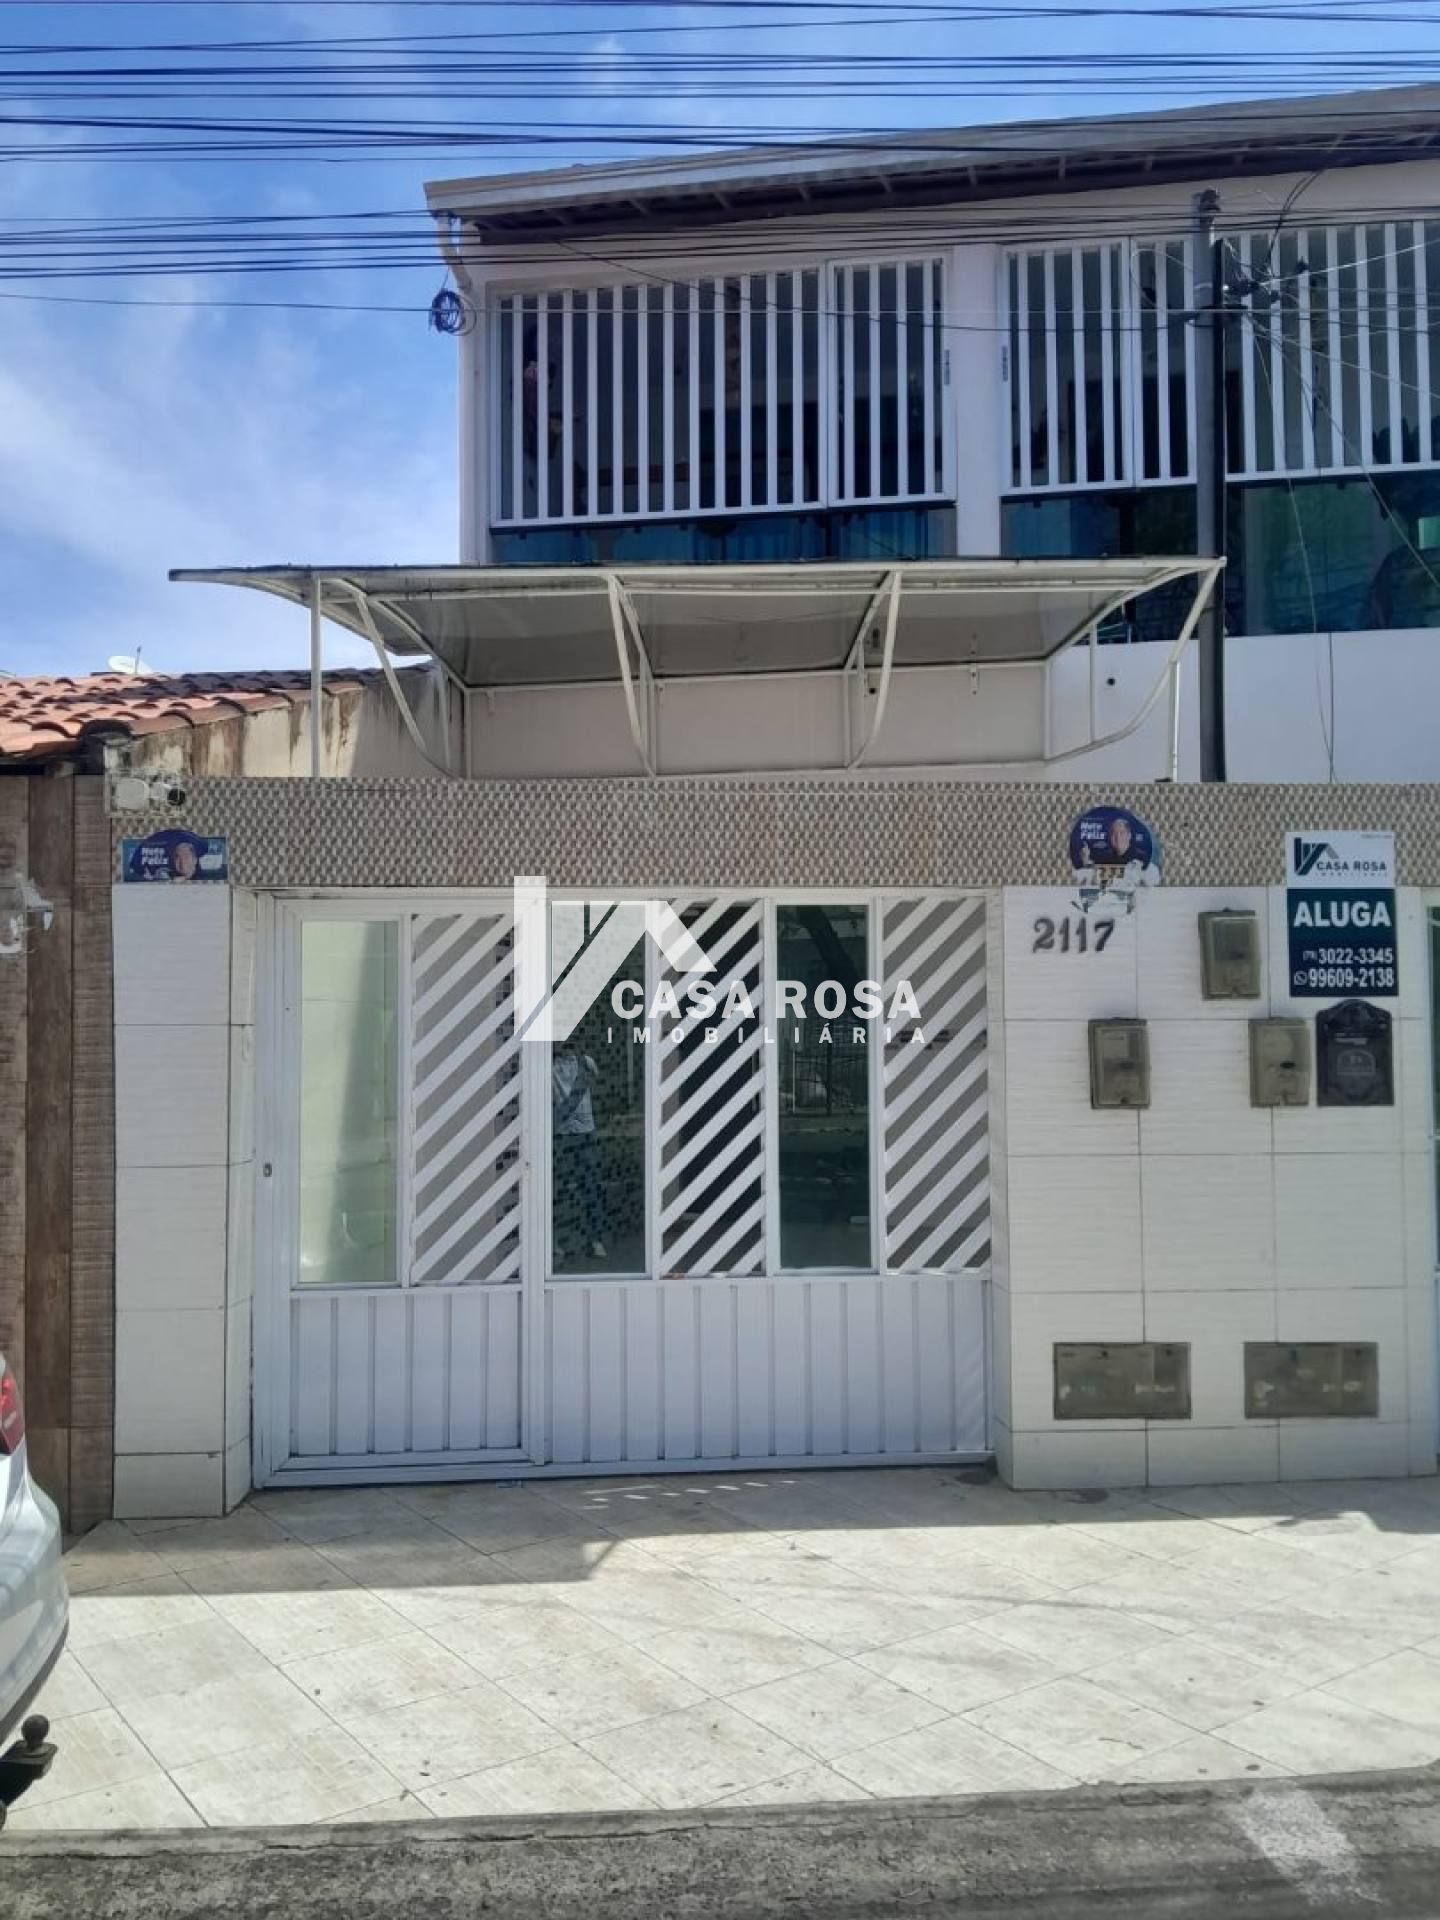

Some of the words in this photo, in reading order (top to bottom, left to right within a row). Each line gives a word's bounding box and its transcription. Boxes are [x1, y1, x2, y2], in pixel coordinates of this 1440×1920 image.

[1316, 860, 1349, 871] CASA
[1353, 860, 1387, 872] ROSA
[1293, 900, 1393, 928] ALUGA
[1032, 916, 1116, 953] 2117
[1318, 946, 1394, 965] 3022-3345
[1308, 966, 1395, 988] 99609-2138
